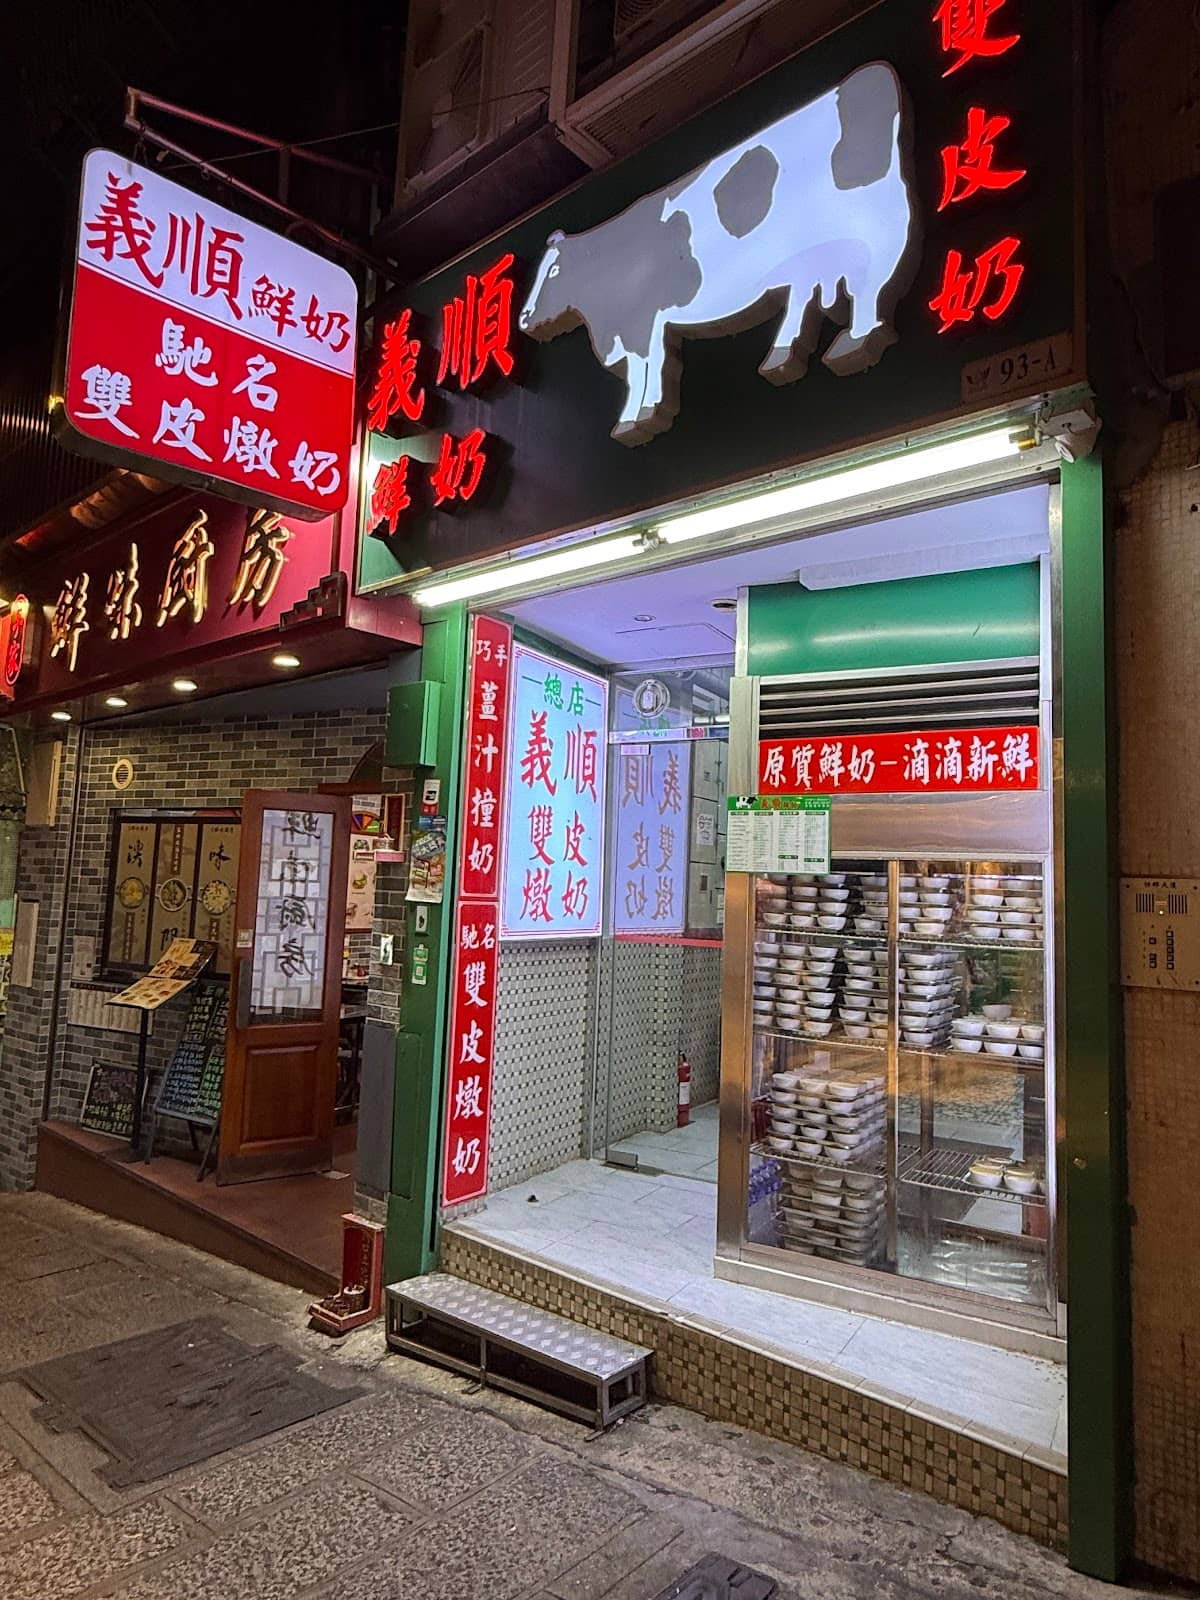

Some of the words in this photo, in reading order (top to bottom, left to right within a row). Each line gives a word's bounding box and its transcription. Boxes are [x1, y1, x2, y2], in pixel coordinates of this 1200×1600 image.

[86, 171, 352, 354] 義順鮮奶
[155, 317, 280, 413] 馳名
[367, 252, 515, 432] 義順
[1000, 344, 1057, 385] 93-A
[74, 363, 341, 496] 雙皮燉奶
[366, 427, 487, 537] 鮮奶
[475, 639, 508, 668] 巧手
[469, 681, 500, 875] 薑汁撞奶
[520, 709, 598, 803] 義順
[528, 804, 589, 867] 雙皮
[460, 923, 496, 951] 馳名
[519, 867, 590, 922] 燉奶
[451, 961, 489, 1178] 雙皮燉奶
